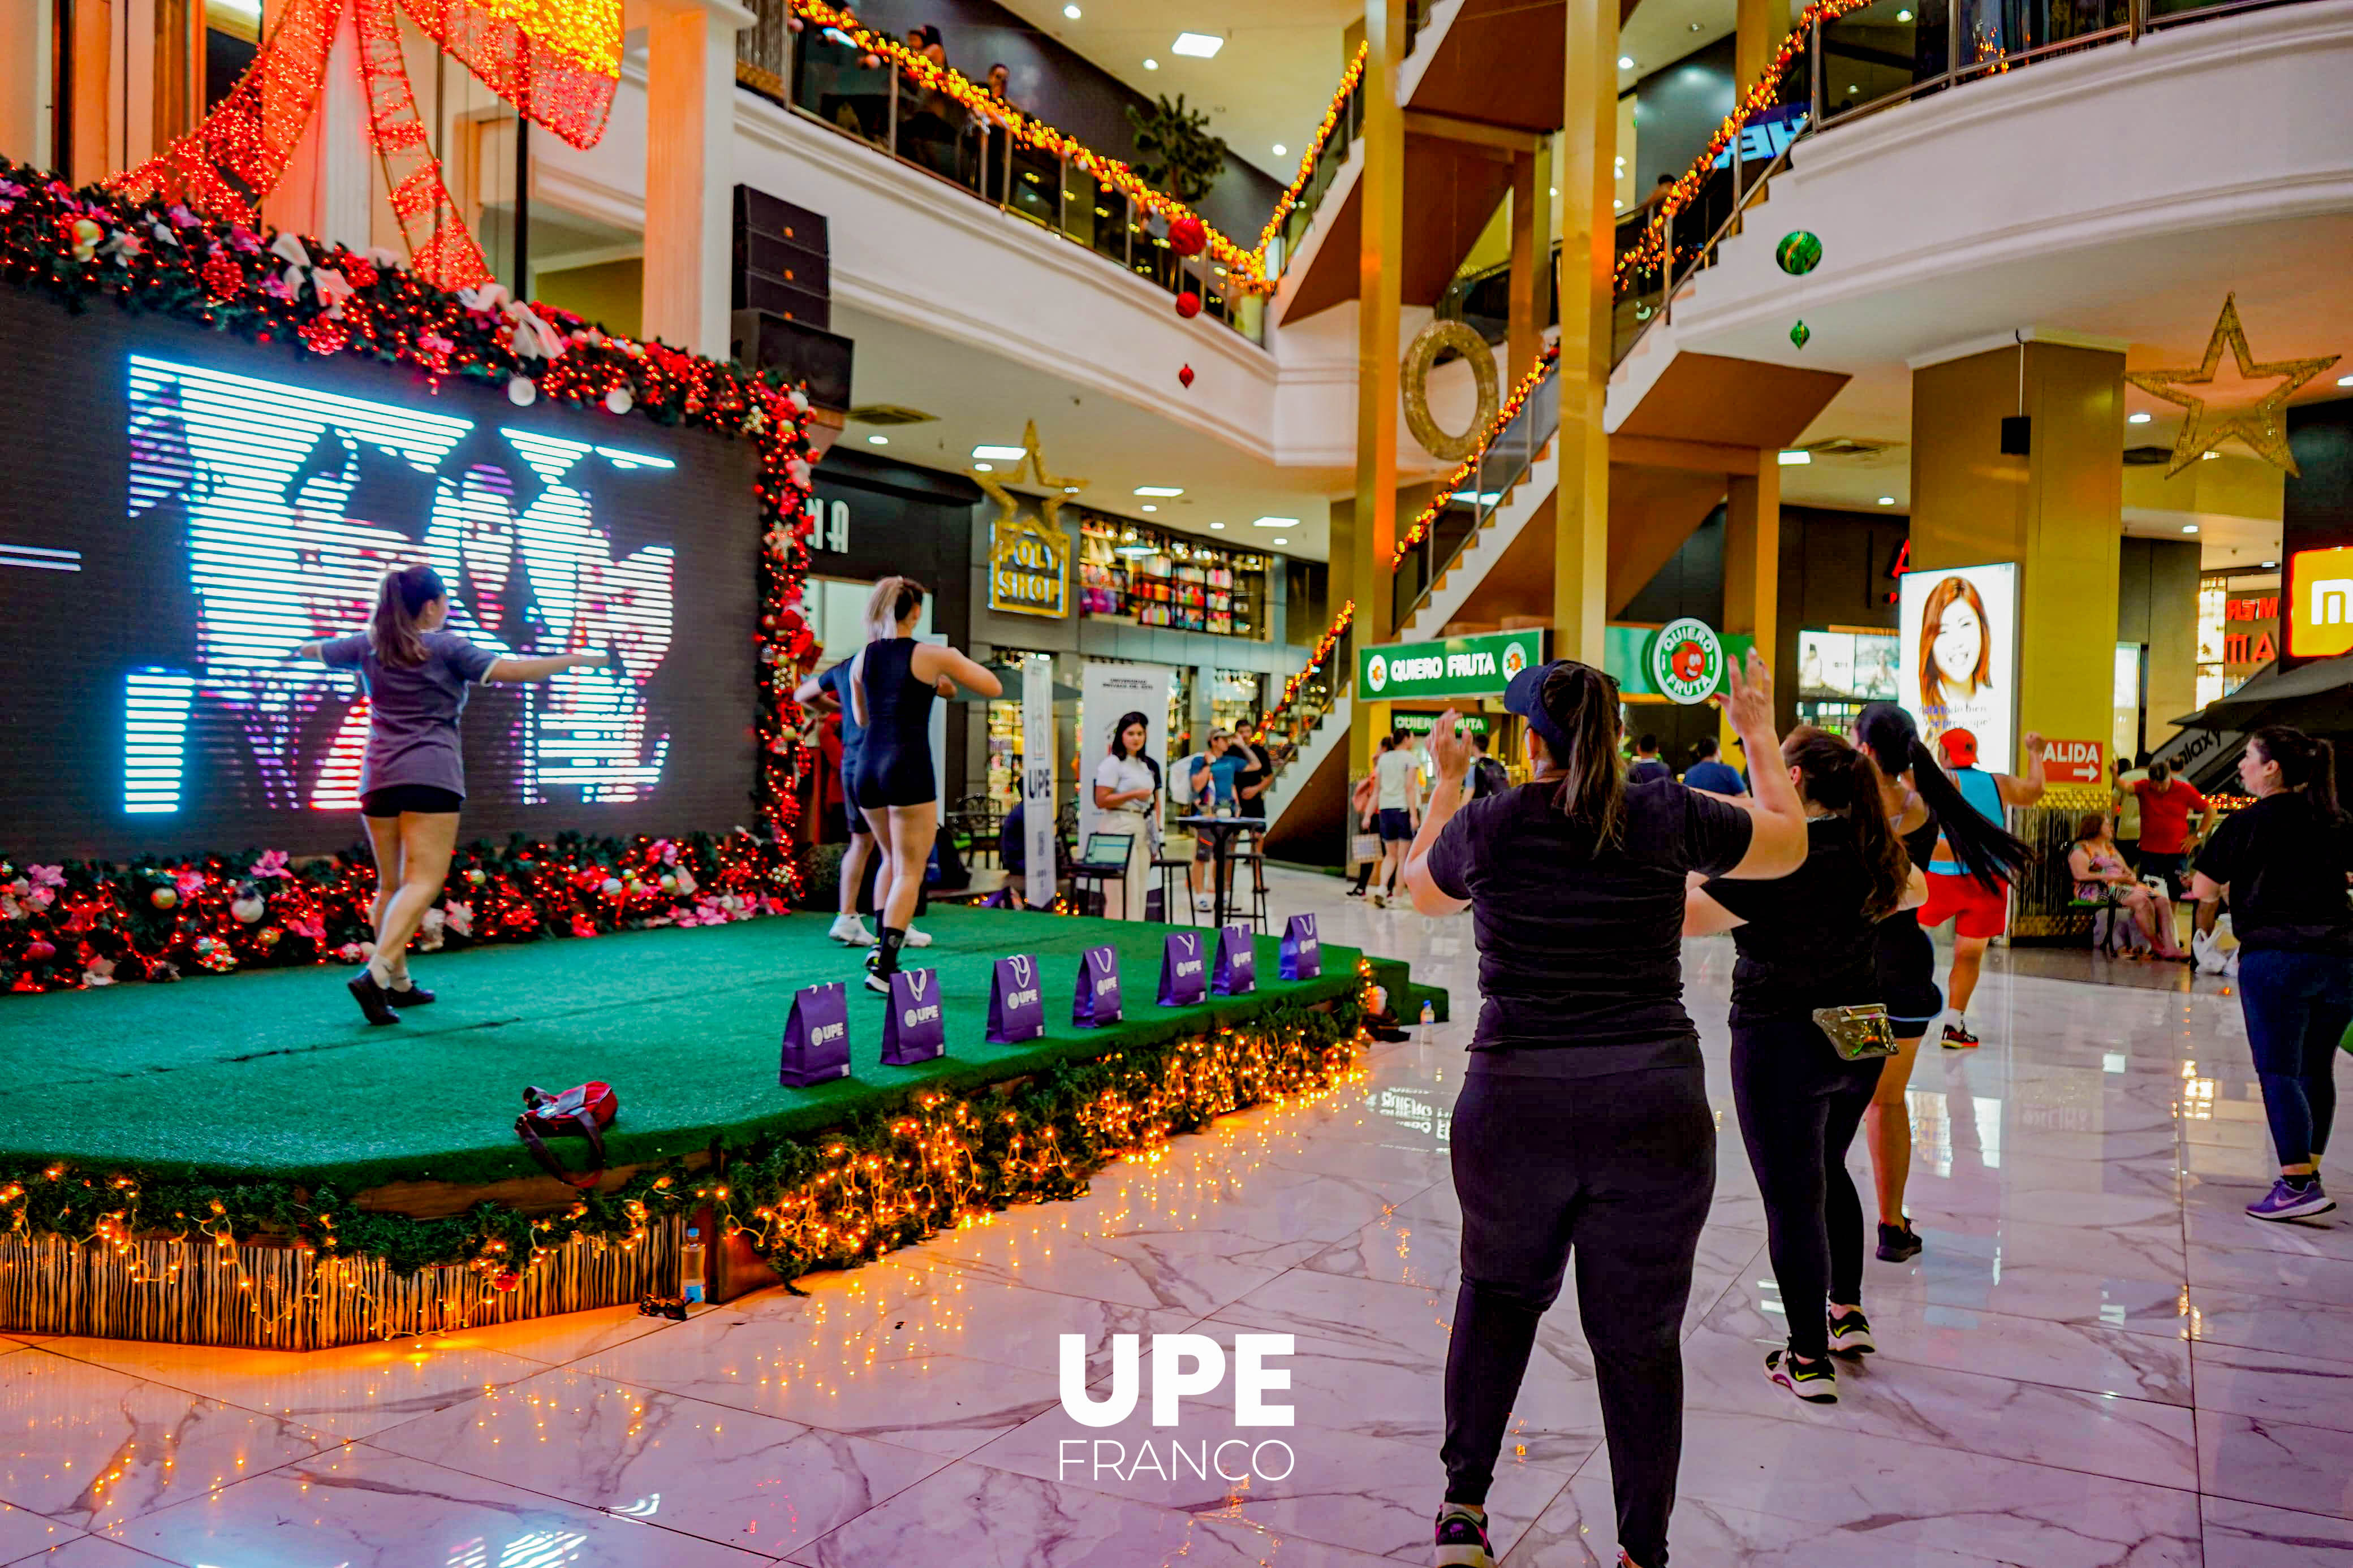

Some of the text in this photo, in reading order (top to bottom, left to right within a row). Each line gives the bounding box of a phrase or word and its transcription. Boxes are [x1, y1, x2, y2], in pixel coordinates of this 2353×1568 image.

[998, 571, 1059, 603] SHOP
[1663, 626, 1714, 653] QUIERO
[1390, 652, 1496, 682] QUIERO FRUTA
[1666, 672, 1712, 696] FRUTA
[1454, 717, 1485, 731] RUTA
[2041, 741, 2099, 763] ALIDA
[1028, 769, 1050, 799] UPE
[1103, 976, 1118, 991] UPE
[1018, 989, 1038, 1004] UPE
[916, 1005, 940, 1022] UPE
[822, 1022, 844, 1040] UPE
